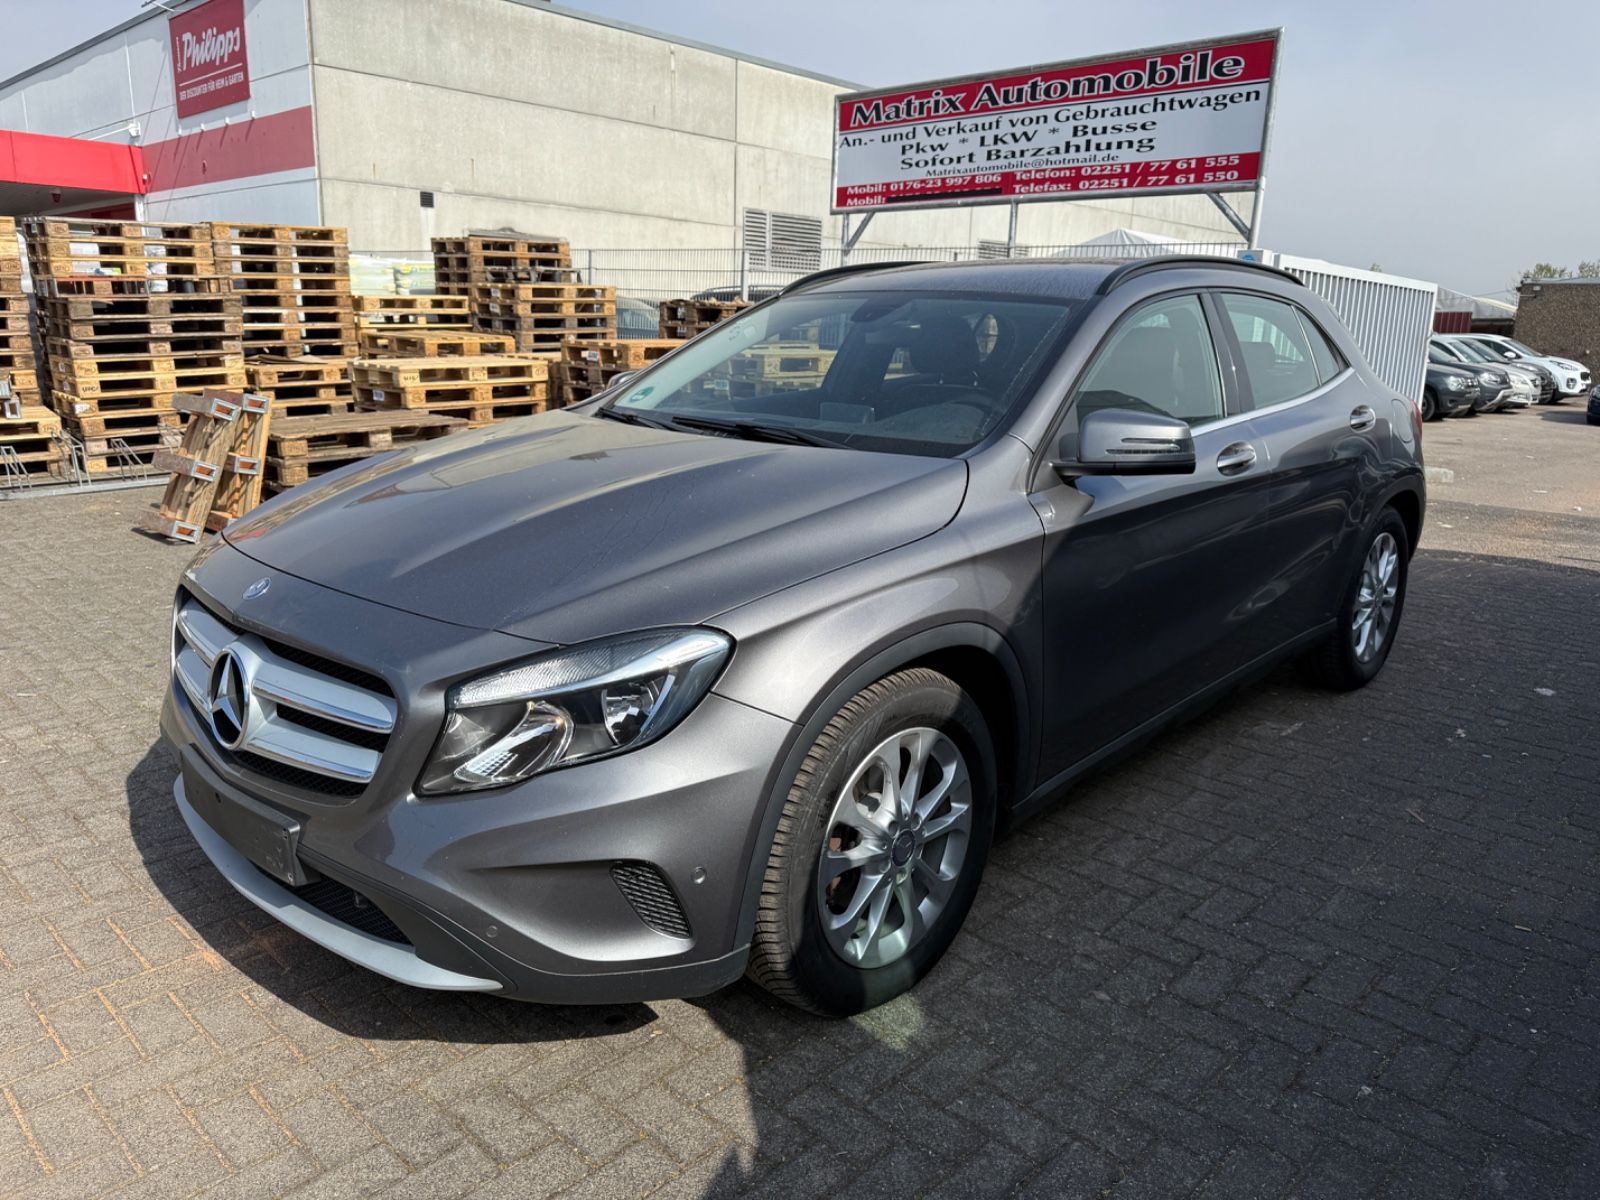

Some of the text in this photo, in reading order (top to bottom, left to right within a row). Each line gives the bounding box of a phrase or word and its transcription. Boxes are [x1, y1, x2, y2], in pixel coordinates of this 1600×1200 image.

[182, 27, 241, 71] Philipps
[850, 50, 1245, 127] Matrix Automobile
[881, 127, 917, 144] und
[923, 116, 1003, 138] Verkauf
[1008, 114, 1048, 128] von
[1054, 90, 1261, 123] Gebrauchtwagen
[900, 120, 1158, 156] Pkw LKW Busse
[900, 137, 1157, 170] Sofort Barzahlung
[925, 153, 1120, 178] Matrixautomobile@hotmail.de
[1013, 168, 1076, 181] Telefon:
[1080, 163, 1131, 177] 02251
[1149, 161, 1172, 172] 77
[1175, 159, 1197, 169] 61
[1204, 155, 1241, 167] 555
[846, 184, 887, 196] Mobil:
[889, 176, 942, 192] 0176-23
[945, 176, 971, 187] 997
[974, 173, 1002, 184] 806
[1012, 182, 1072, 194] Telefax:
[1078, 177, 1129, 190] 02251
[1146, 175, 1169, 186] 77
[1174, 173, 1196, 184] 61
[1202, 170, 1239, 182] 550
[846, 195, 887, 207] Mobil:
